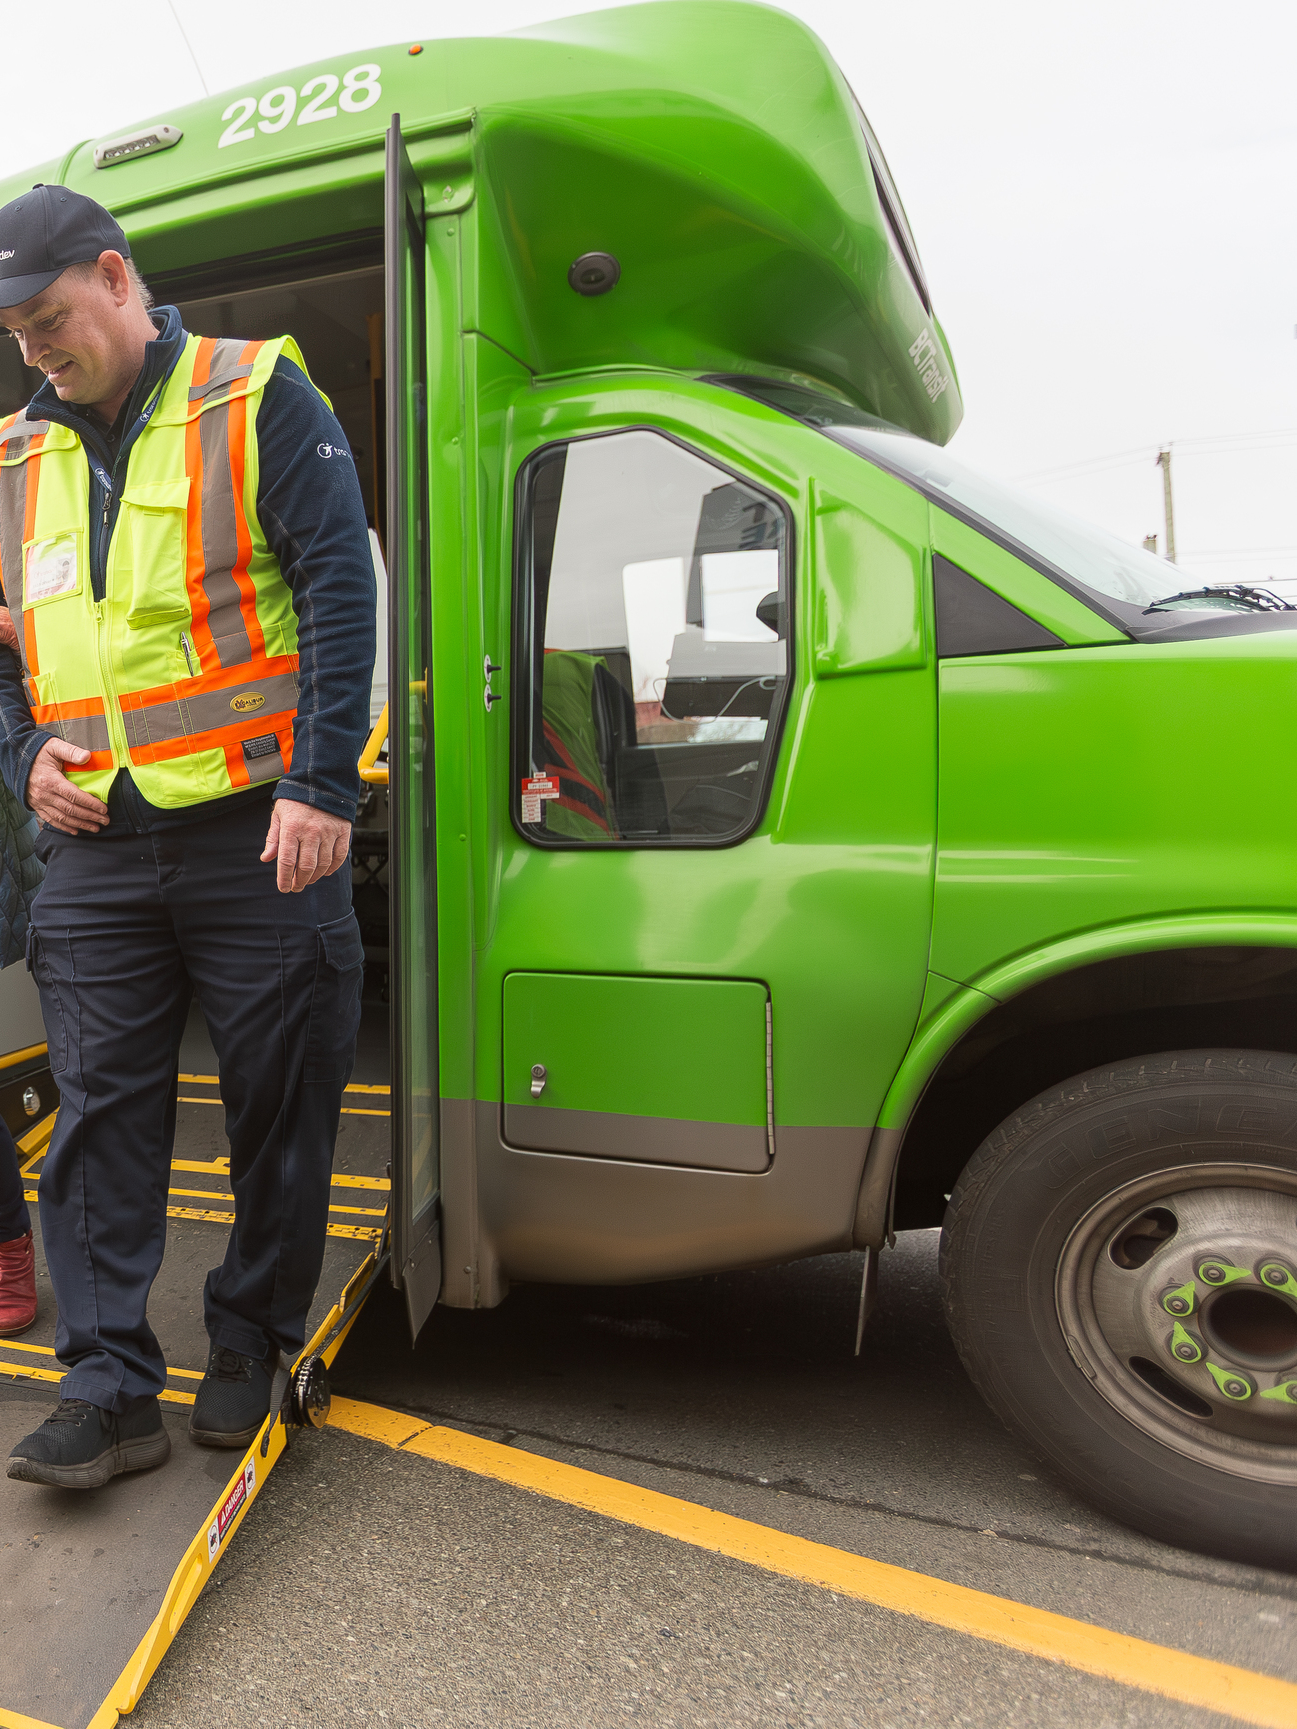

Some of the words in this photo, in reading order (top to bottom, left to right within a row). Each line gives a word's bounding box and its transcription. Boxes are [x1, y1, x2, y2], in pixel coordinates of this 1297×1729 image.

[217, 63, 382, 148] 2928
[908, 327, 949, 404] BCTransit
[1038, 1097, 1297, 1189] GENE
[224, 1479, 244, 1518] DANGER
